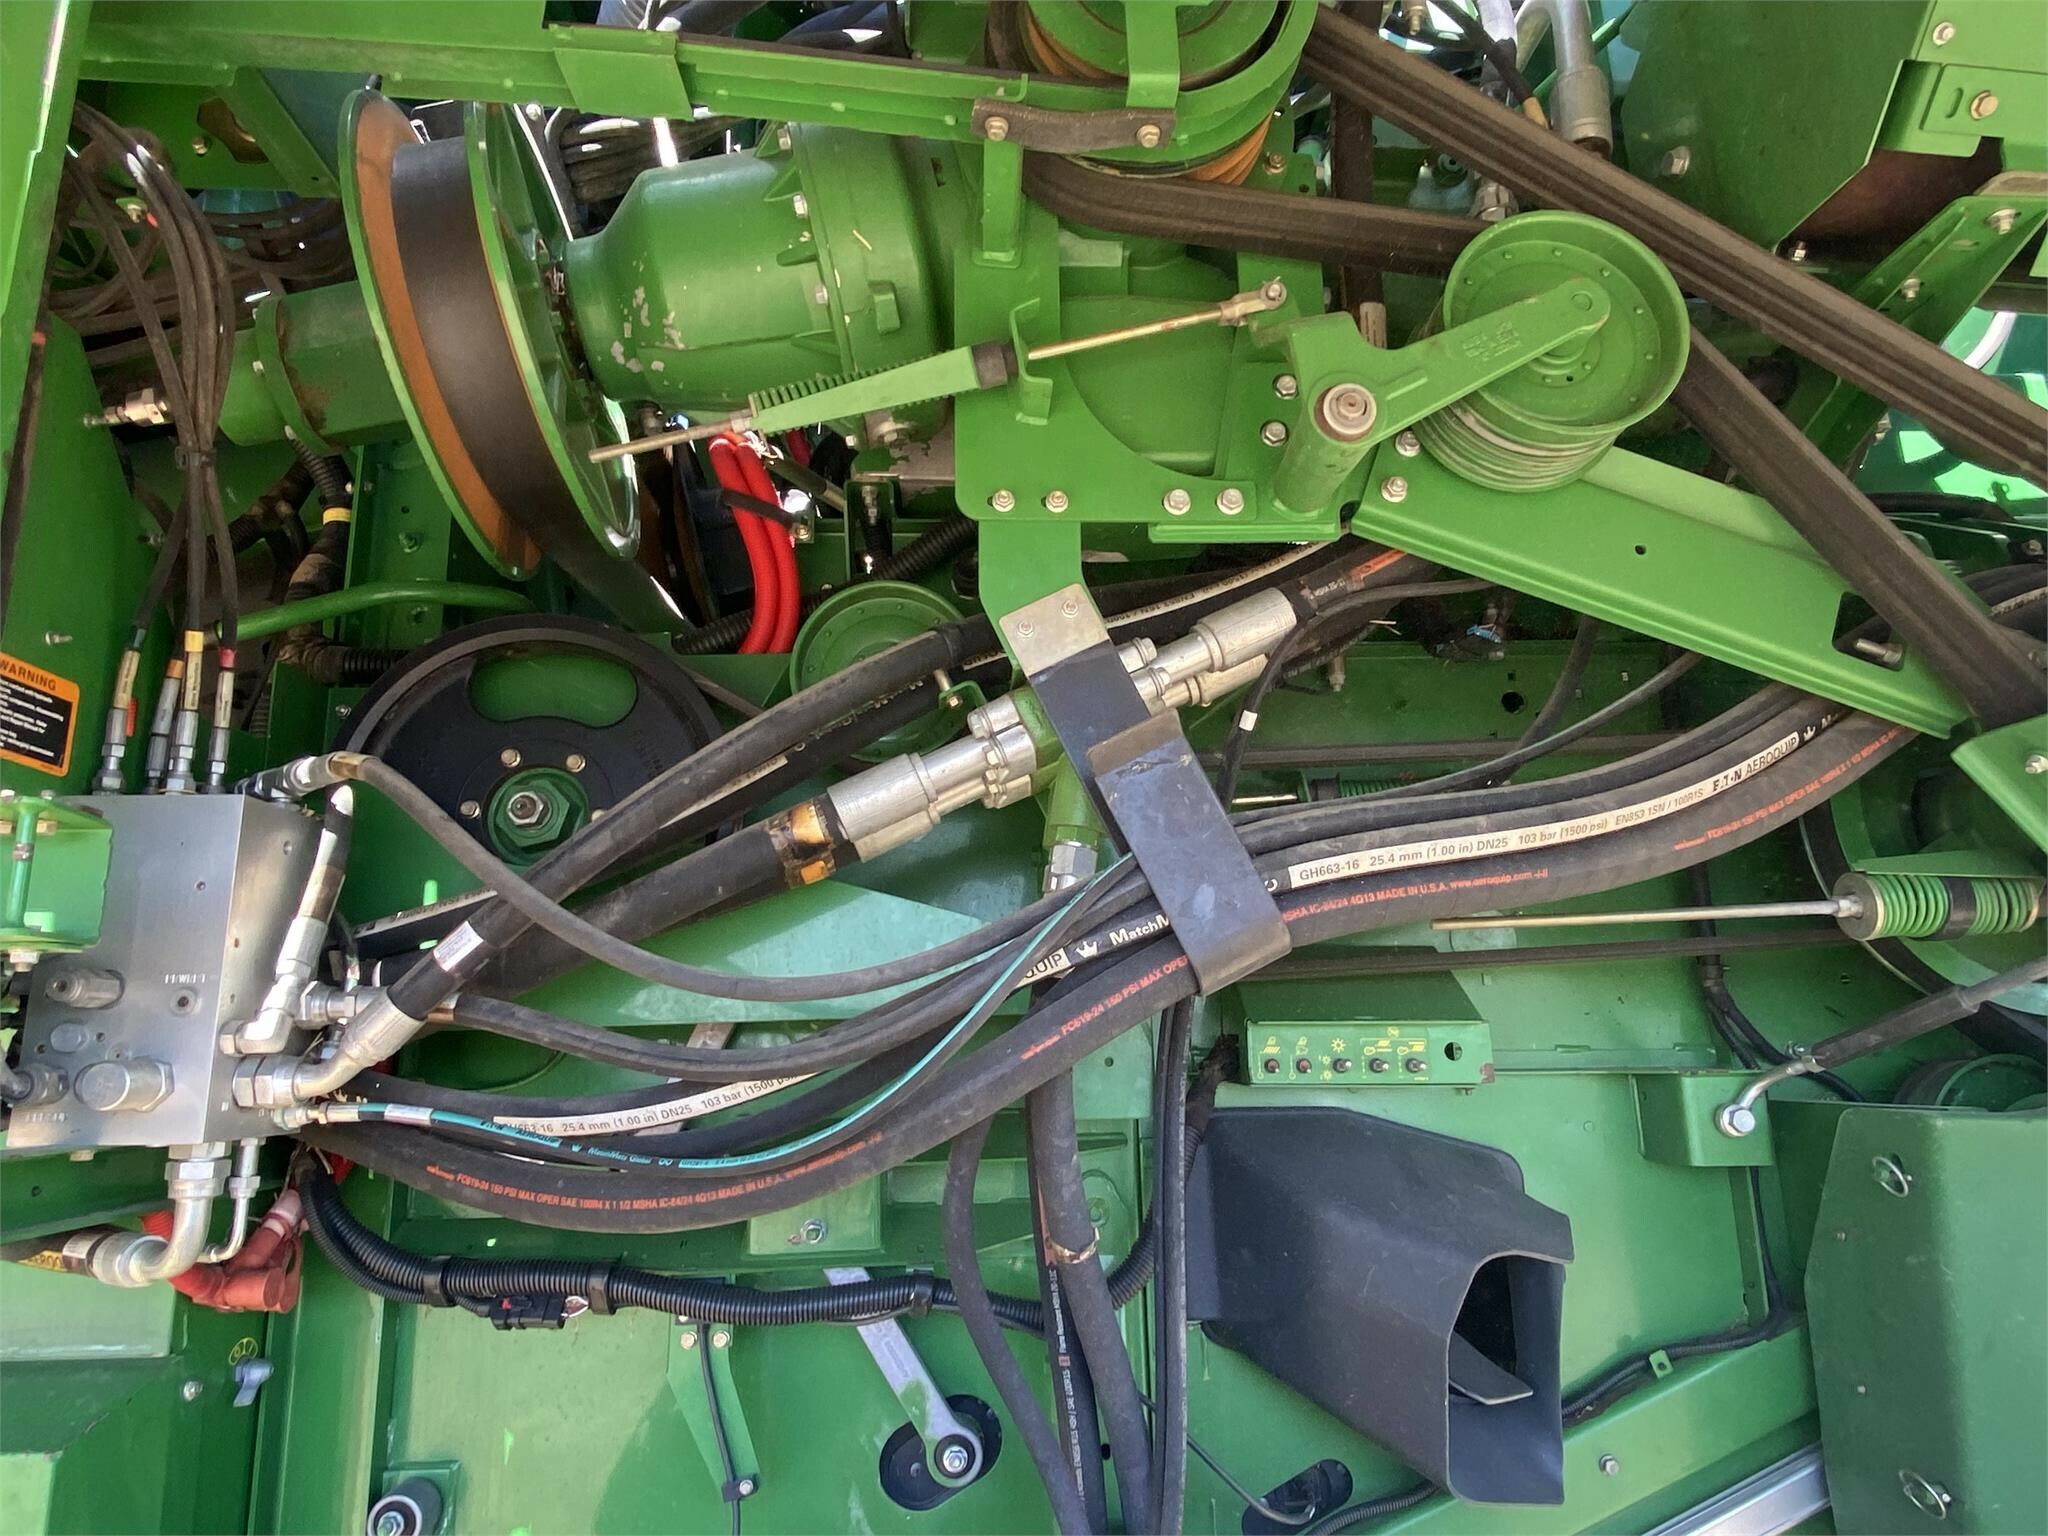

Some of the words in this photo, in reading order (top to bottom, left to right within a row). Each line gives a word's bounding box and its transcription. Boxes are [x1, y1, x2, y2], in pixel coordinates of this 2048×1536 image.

[0, 660, 57, 691] WARNING
[1299, 859, 1360, 881] GH663-16
[1369, 852, 1395, 868] 25.4
[1399, 850, 1423, 863] mm
[1426, 844, 1455, 860] (1.00
[1458, 840, 1474, 854] in)
[1477, 837, 1509, 851] DN25
[1518, 830, 1537, 845] 103
[1539, 829, 1557, 842] bar
[1559, 820, 1588, 839] (1500
[1589, 817, 1608, 834] psi)
[1615, 809, 1645, 826] EN853
[1648, 801, 1666, 818] 1SN
[1744, 735, 1797, 776] AEROQUIP
[1376, 886, 1406, 902] MADE
[1407, 884, 1419, 897] IN
[1123, 984, 1140, 998] PSI
[1140, 971, 1164, 988] MAX
[589, 1120, 611, 1130] mm
[660, 1103, 693, 1118] DN25
[701, 1096, 721, 1109] 103
[723, 1089, 742, 1103] bar
[743, 1078, 775, 1097] (1500
[503, 1186, 517, 1198] PSI
[517, 1190, 537, 1201] MAX
[536, 1192, 560, 1205] OPER
[560, 1196, 577, 1208] SAE
[718, 1184, 745, 1199] MADE
[745, 1181, 756, 1193] IN
